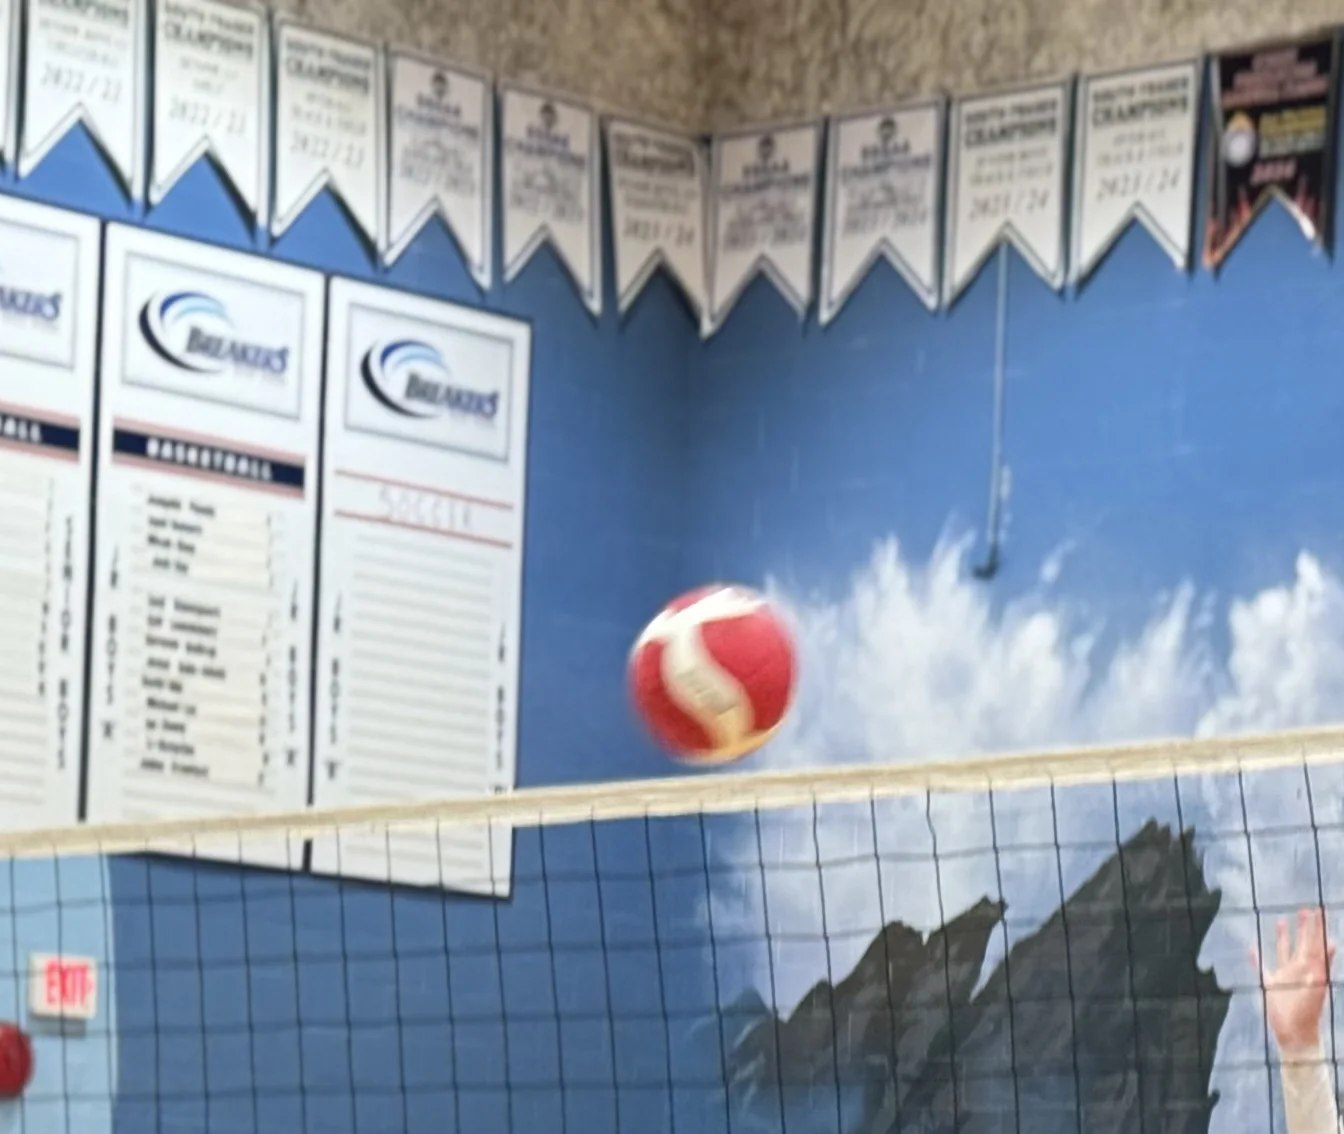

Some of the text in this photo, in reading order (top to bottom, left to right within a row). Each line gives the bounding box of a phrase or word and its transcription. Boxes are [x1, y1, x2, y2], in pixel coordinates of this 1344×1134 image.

[186, 325, 289, 375] BREAKERS
[404, 372, 499, 420] BREAKERS
[146, 437, 273, 482] BASKETBALL
[46, 962, 89, 1007] EXIT
